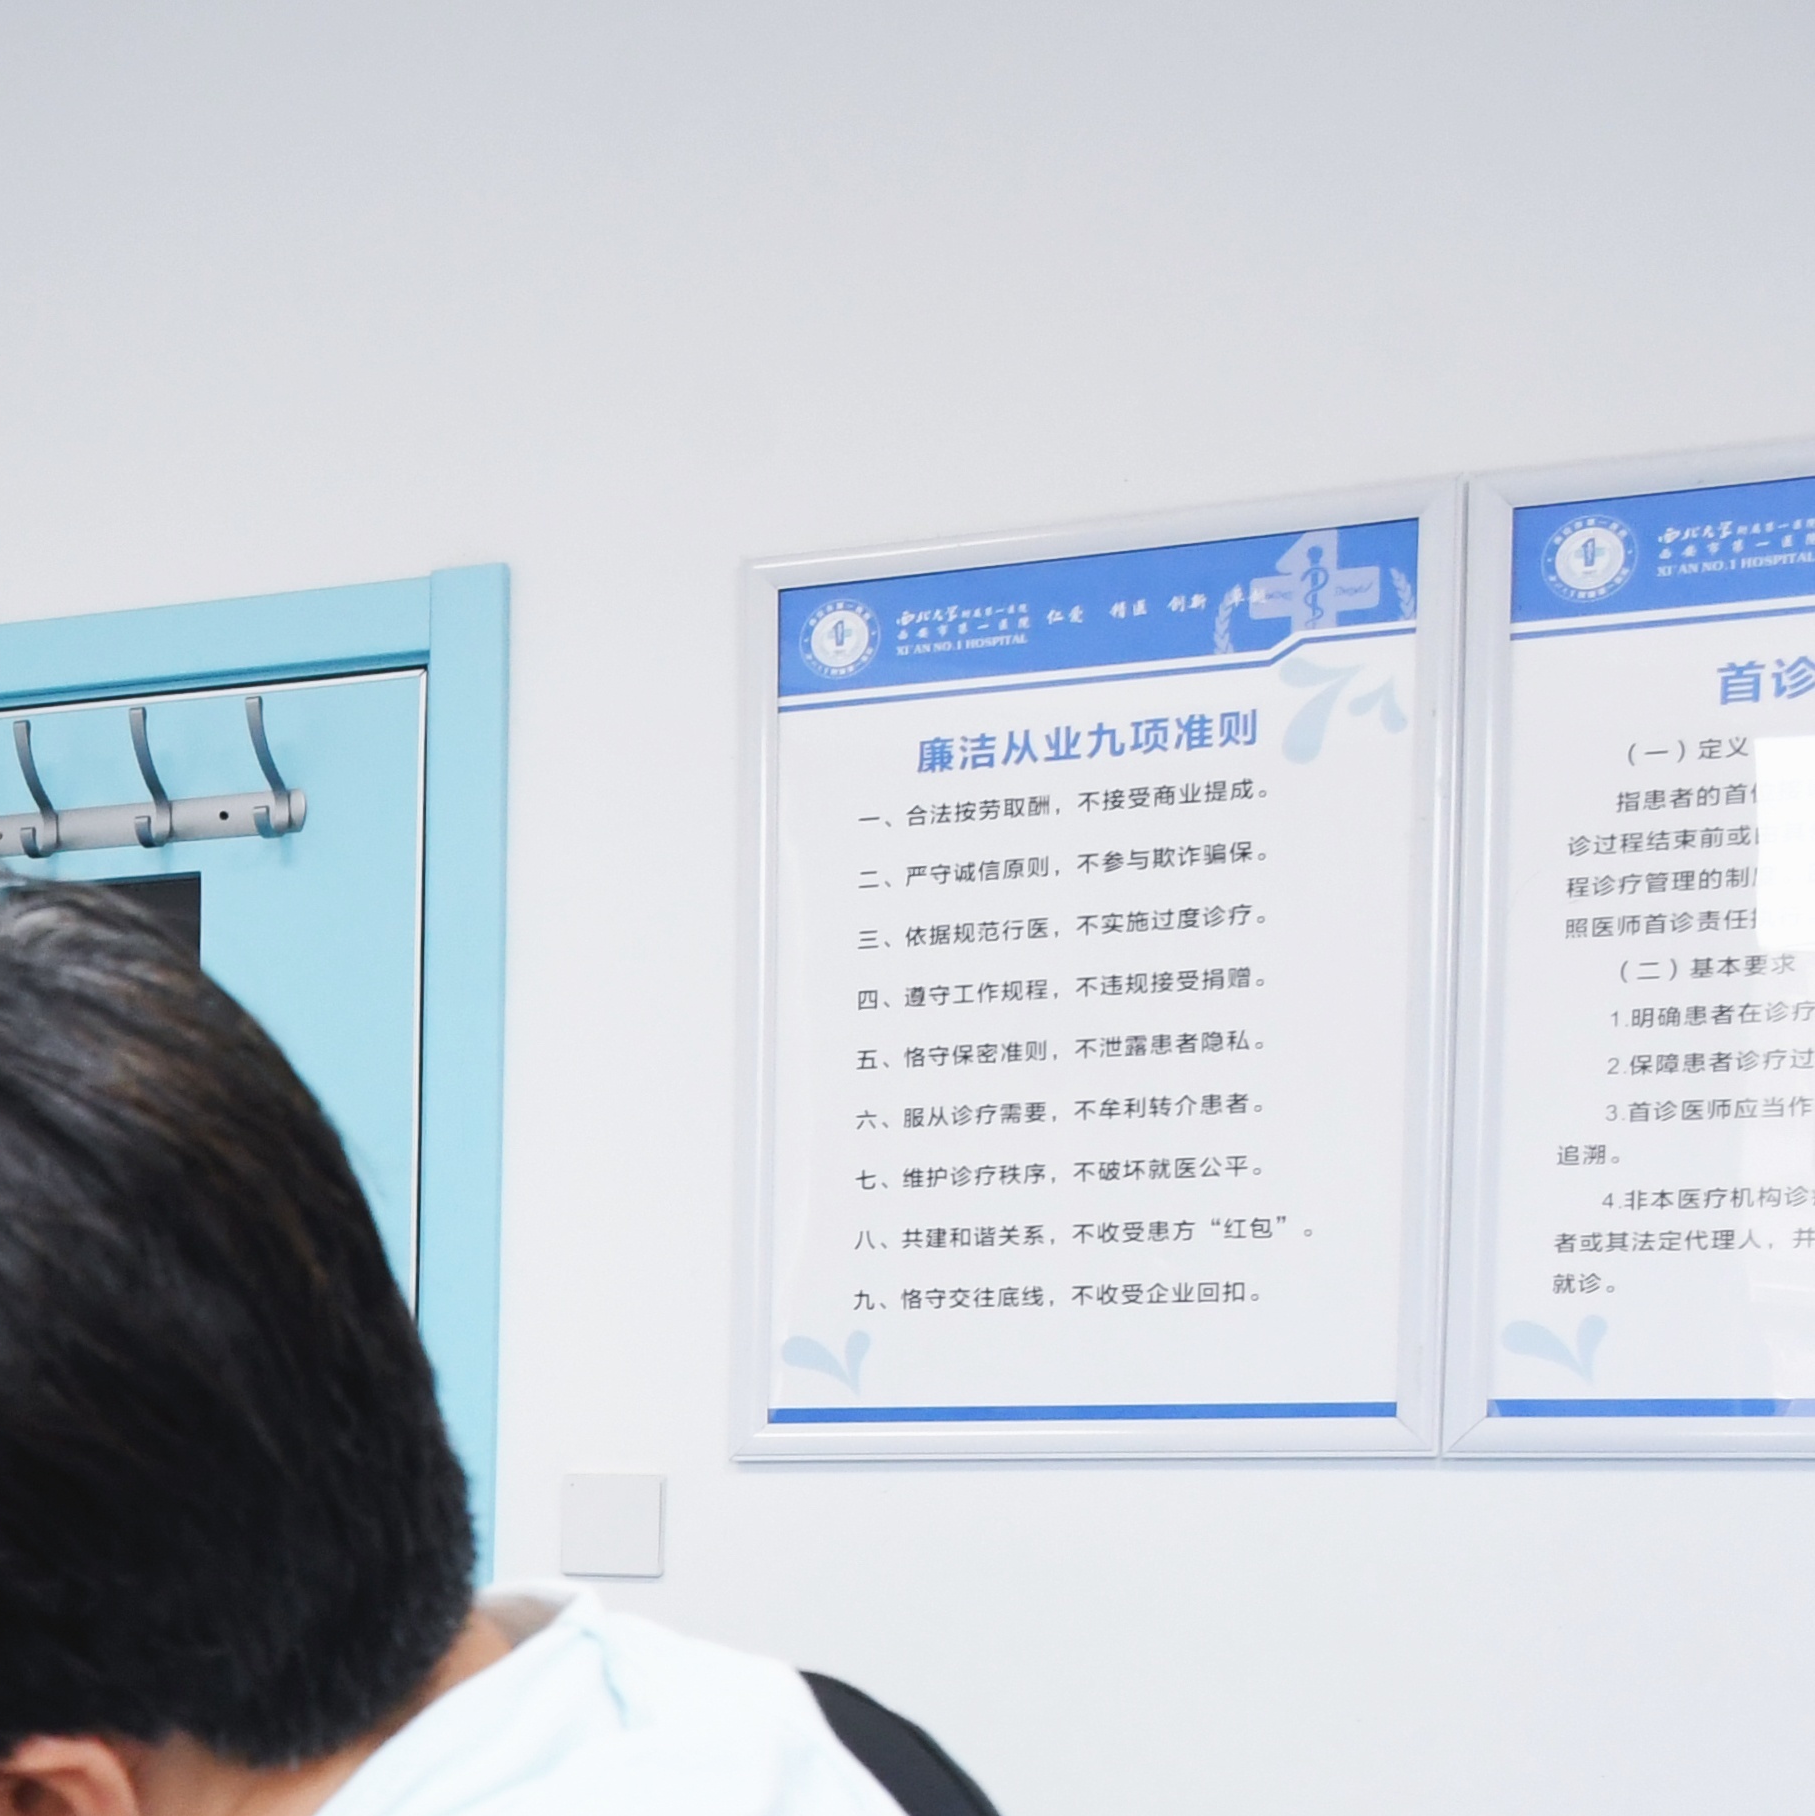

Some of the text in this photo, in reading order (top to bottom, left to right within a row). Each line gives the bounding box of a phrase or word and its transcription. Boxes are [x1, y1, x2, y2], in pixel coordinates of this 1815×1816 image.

[1741, 552, 1815, 569] HOSPITAL
[965, 634, 1028, 649] HOSPITAL
[1716, 655, 1815, 705] 首诊
[916, 708, 1258, 774] 廉洁从业九项准则
[1567, 825, 1760, 857] 诊过程结束前或
[1565, 866, 1758, 899] 程诊疗管理的制
[1552, 1272, 1616, 1295] 就诊。
